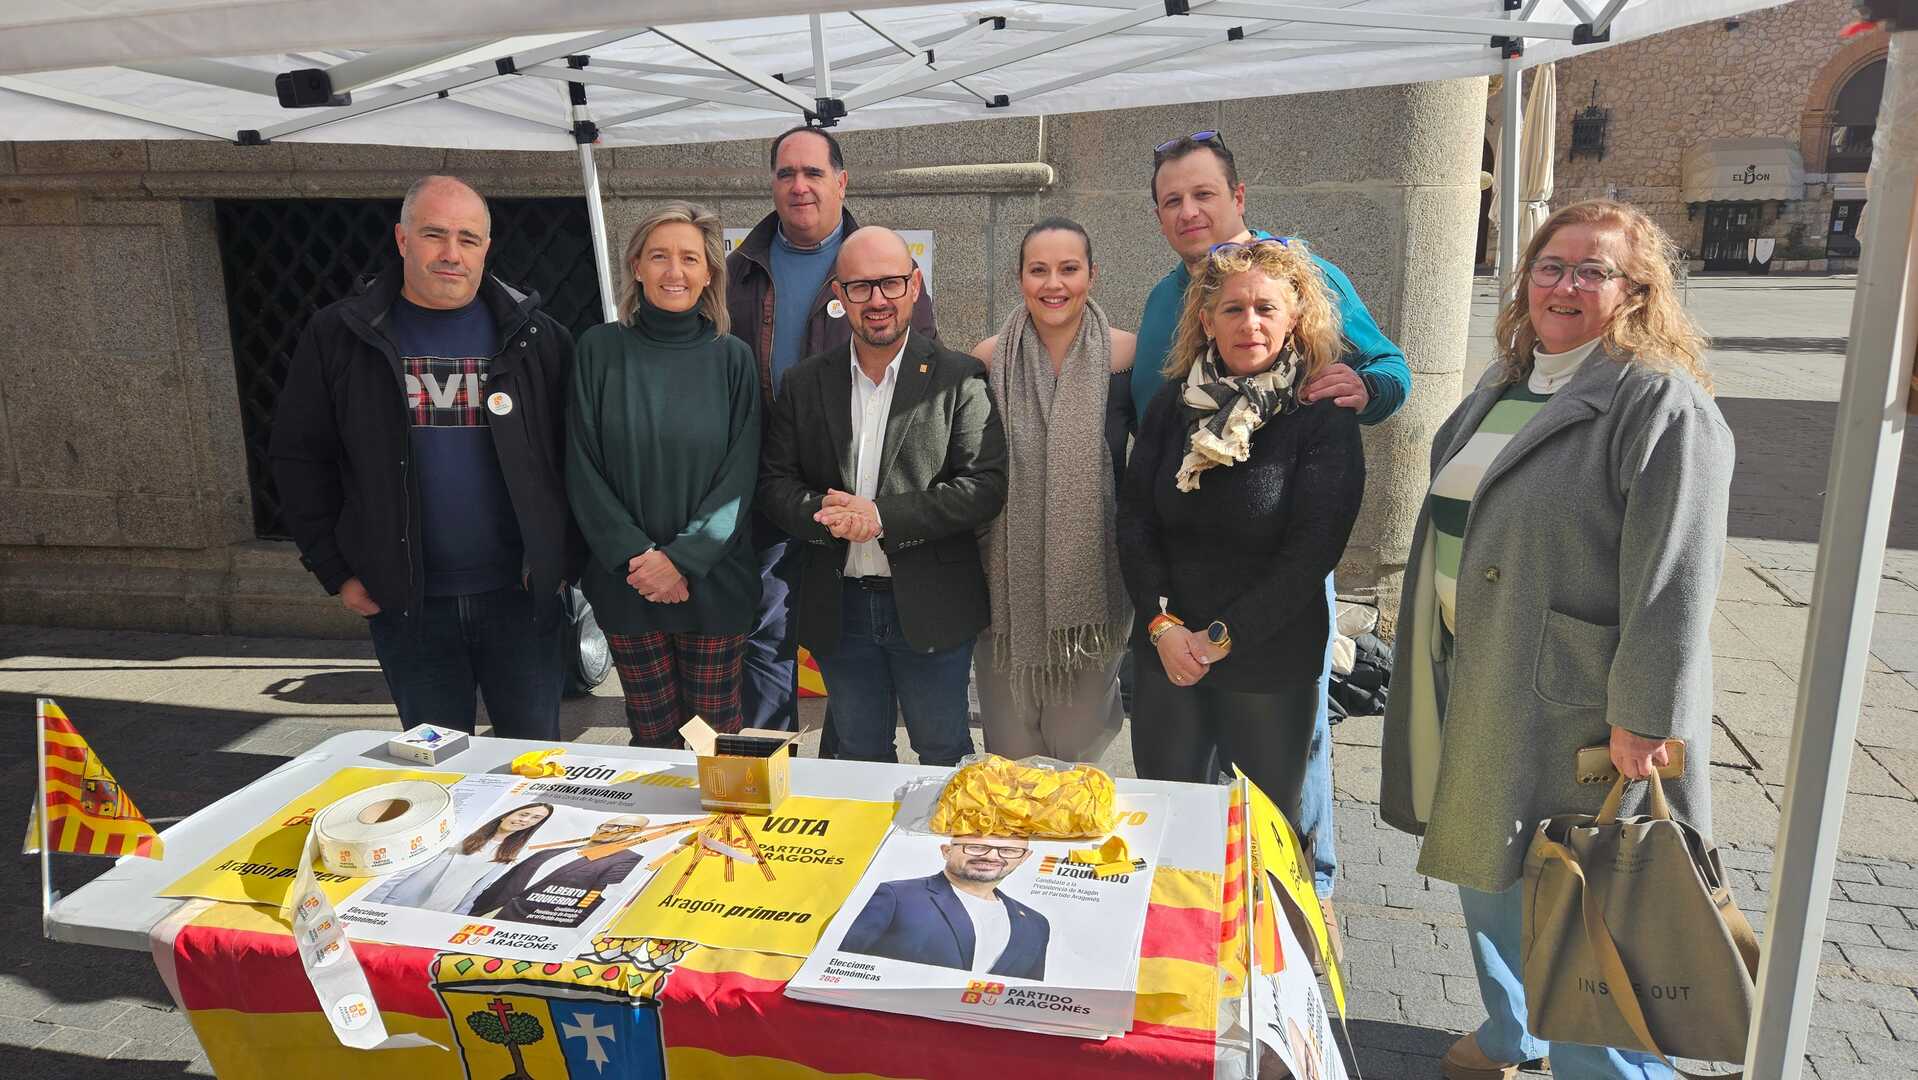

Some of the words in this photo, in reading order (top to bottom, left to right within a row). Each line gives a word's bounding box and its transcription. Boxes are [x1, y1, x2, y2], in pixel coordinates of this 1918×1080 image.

[529, 783, 580, 794] CRISTINA
[580, 787, 633, 800] NAVARRO
[761, 816, 830, 836] VOTA
[758, 844, 828, 856] PARTIDO
[764, 853, 845, 865] RAGONÉS
[214, 860, 278, 879] Aragón
[542, 885, 587, 898] ALBERTO
[526, 892, 578, 906] IZQUIERDO
[347, 906, 389, 917] Elecciones
[658, 894, 725, 913] Aragón
[722, 905, 812, 924] primero
[493, 930, 549, 942] PARTIDO
[486, 938, 558, 951] ARAGONÉS
[829, 958, 876, 971] Elecciones
[819, 974, 841, 983] 2026
[824, 966, 882, 982] Autonómicas
[1578, 977, 1641, 998] INSE
[1651, 985, 1691, 1000] OUT
[1008, 988, 1073, 1004] PARTIDO
[1004, 998, 1091, 1015] ARAGONÉS
